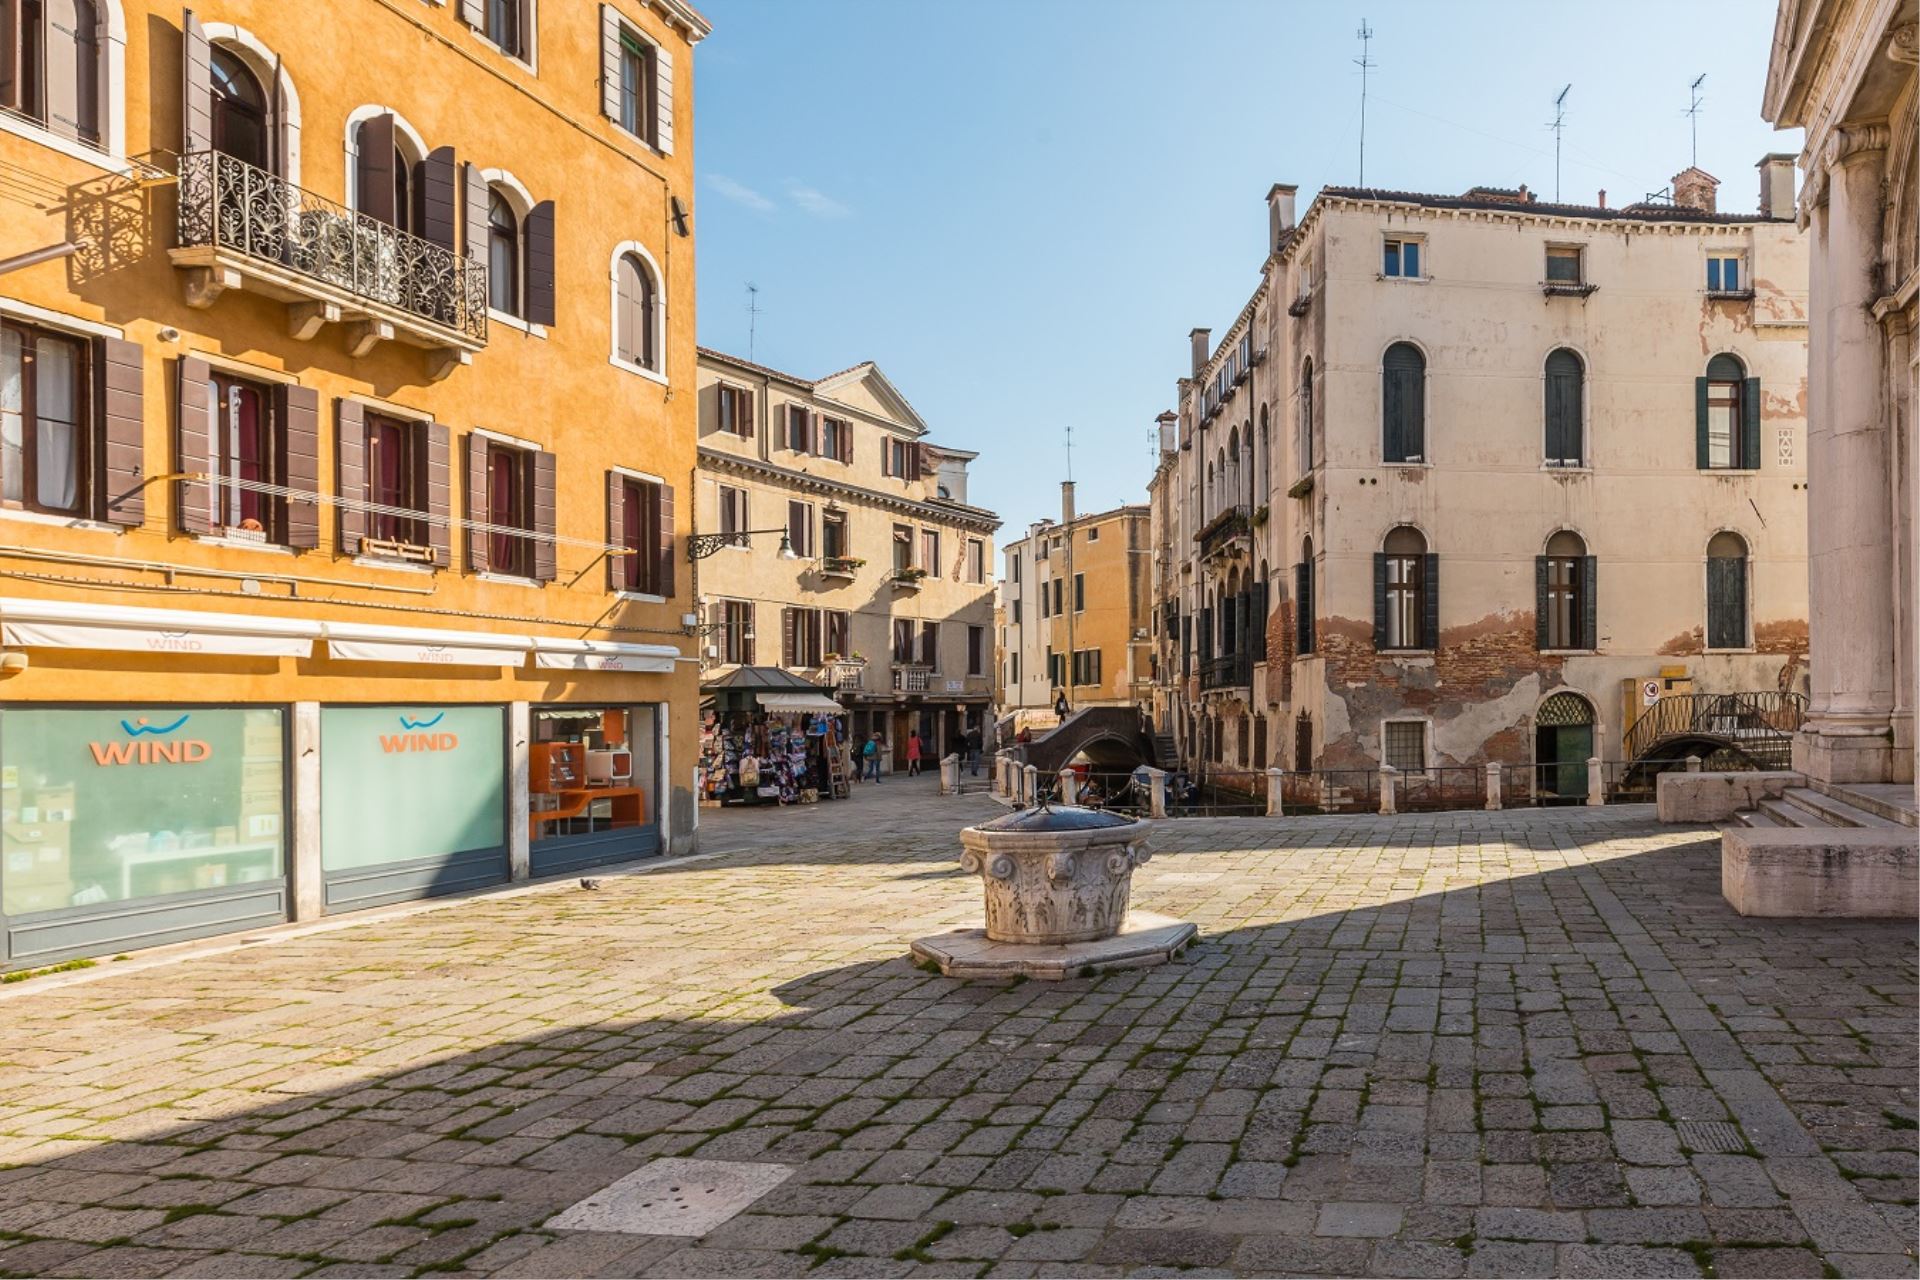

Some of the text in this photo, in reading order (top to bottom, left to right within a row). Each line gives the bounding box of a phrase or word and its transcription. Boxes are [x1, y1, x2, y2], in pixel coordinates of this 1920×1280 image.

[146, 639, 202, 651] WIND
[417, 652, 454, 662] WIND
[600, 661, 624, 669] WIND
[379, 733, 459, 752] WIND
[89, 740, 212, 766] WIND
